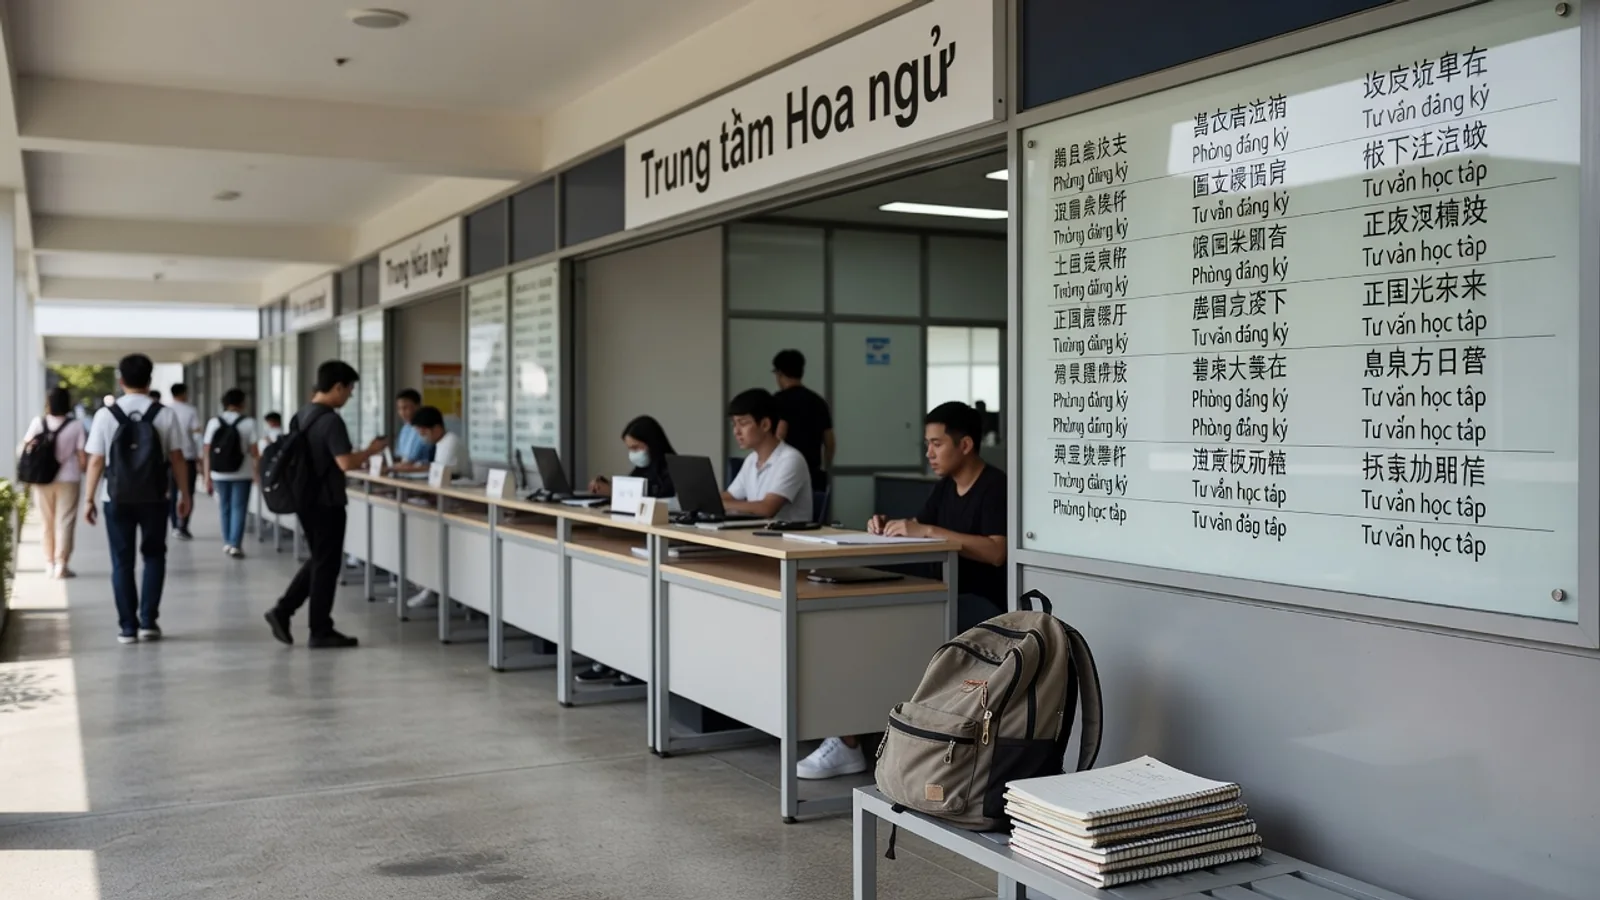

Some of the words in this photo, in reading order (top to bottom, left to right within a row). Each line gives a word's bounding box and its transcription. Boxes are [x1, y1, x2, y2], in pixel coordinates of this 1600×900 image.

[641, 138, 711, 199] Trung
[786, 85, 855, 150] Hoa
[1362, 178, 1384, 198] Tư
[1422, 167, 1453, 193] học
[1362, 247, 1384, 267] Tư
[1421, 239, 1453, 265] học
[1192, 265, 1232, 287] Phòng
[1362, 317, 1384, 336] Tư
[1421, 312, 1453, 338] học
[1192, 389, 1232, 413] Phòng
[1362, 387, 1384, 407] Tư
[1421, 385, 1452, 411] học
[1192, 417, 1232, 442] Phòng
[1362, 419, 1383, 439] Tư
[1421, 418, 1452, 446] học
[1237, 481, 1261, 505] học
[1361, 489, 1383, 510] Tư
[1420, 492, 1452, 521] học
[1361, 525, 1383, 546] Tư
[1420, 527, 1452, 557] học
